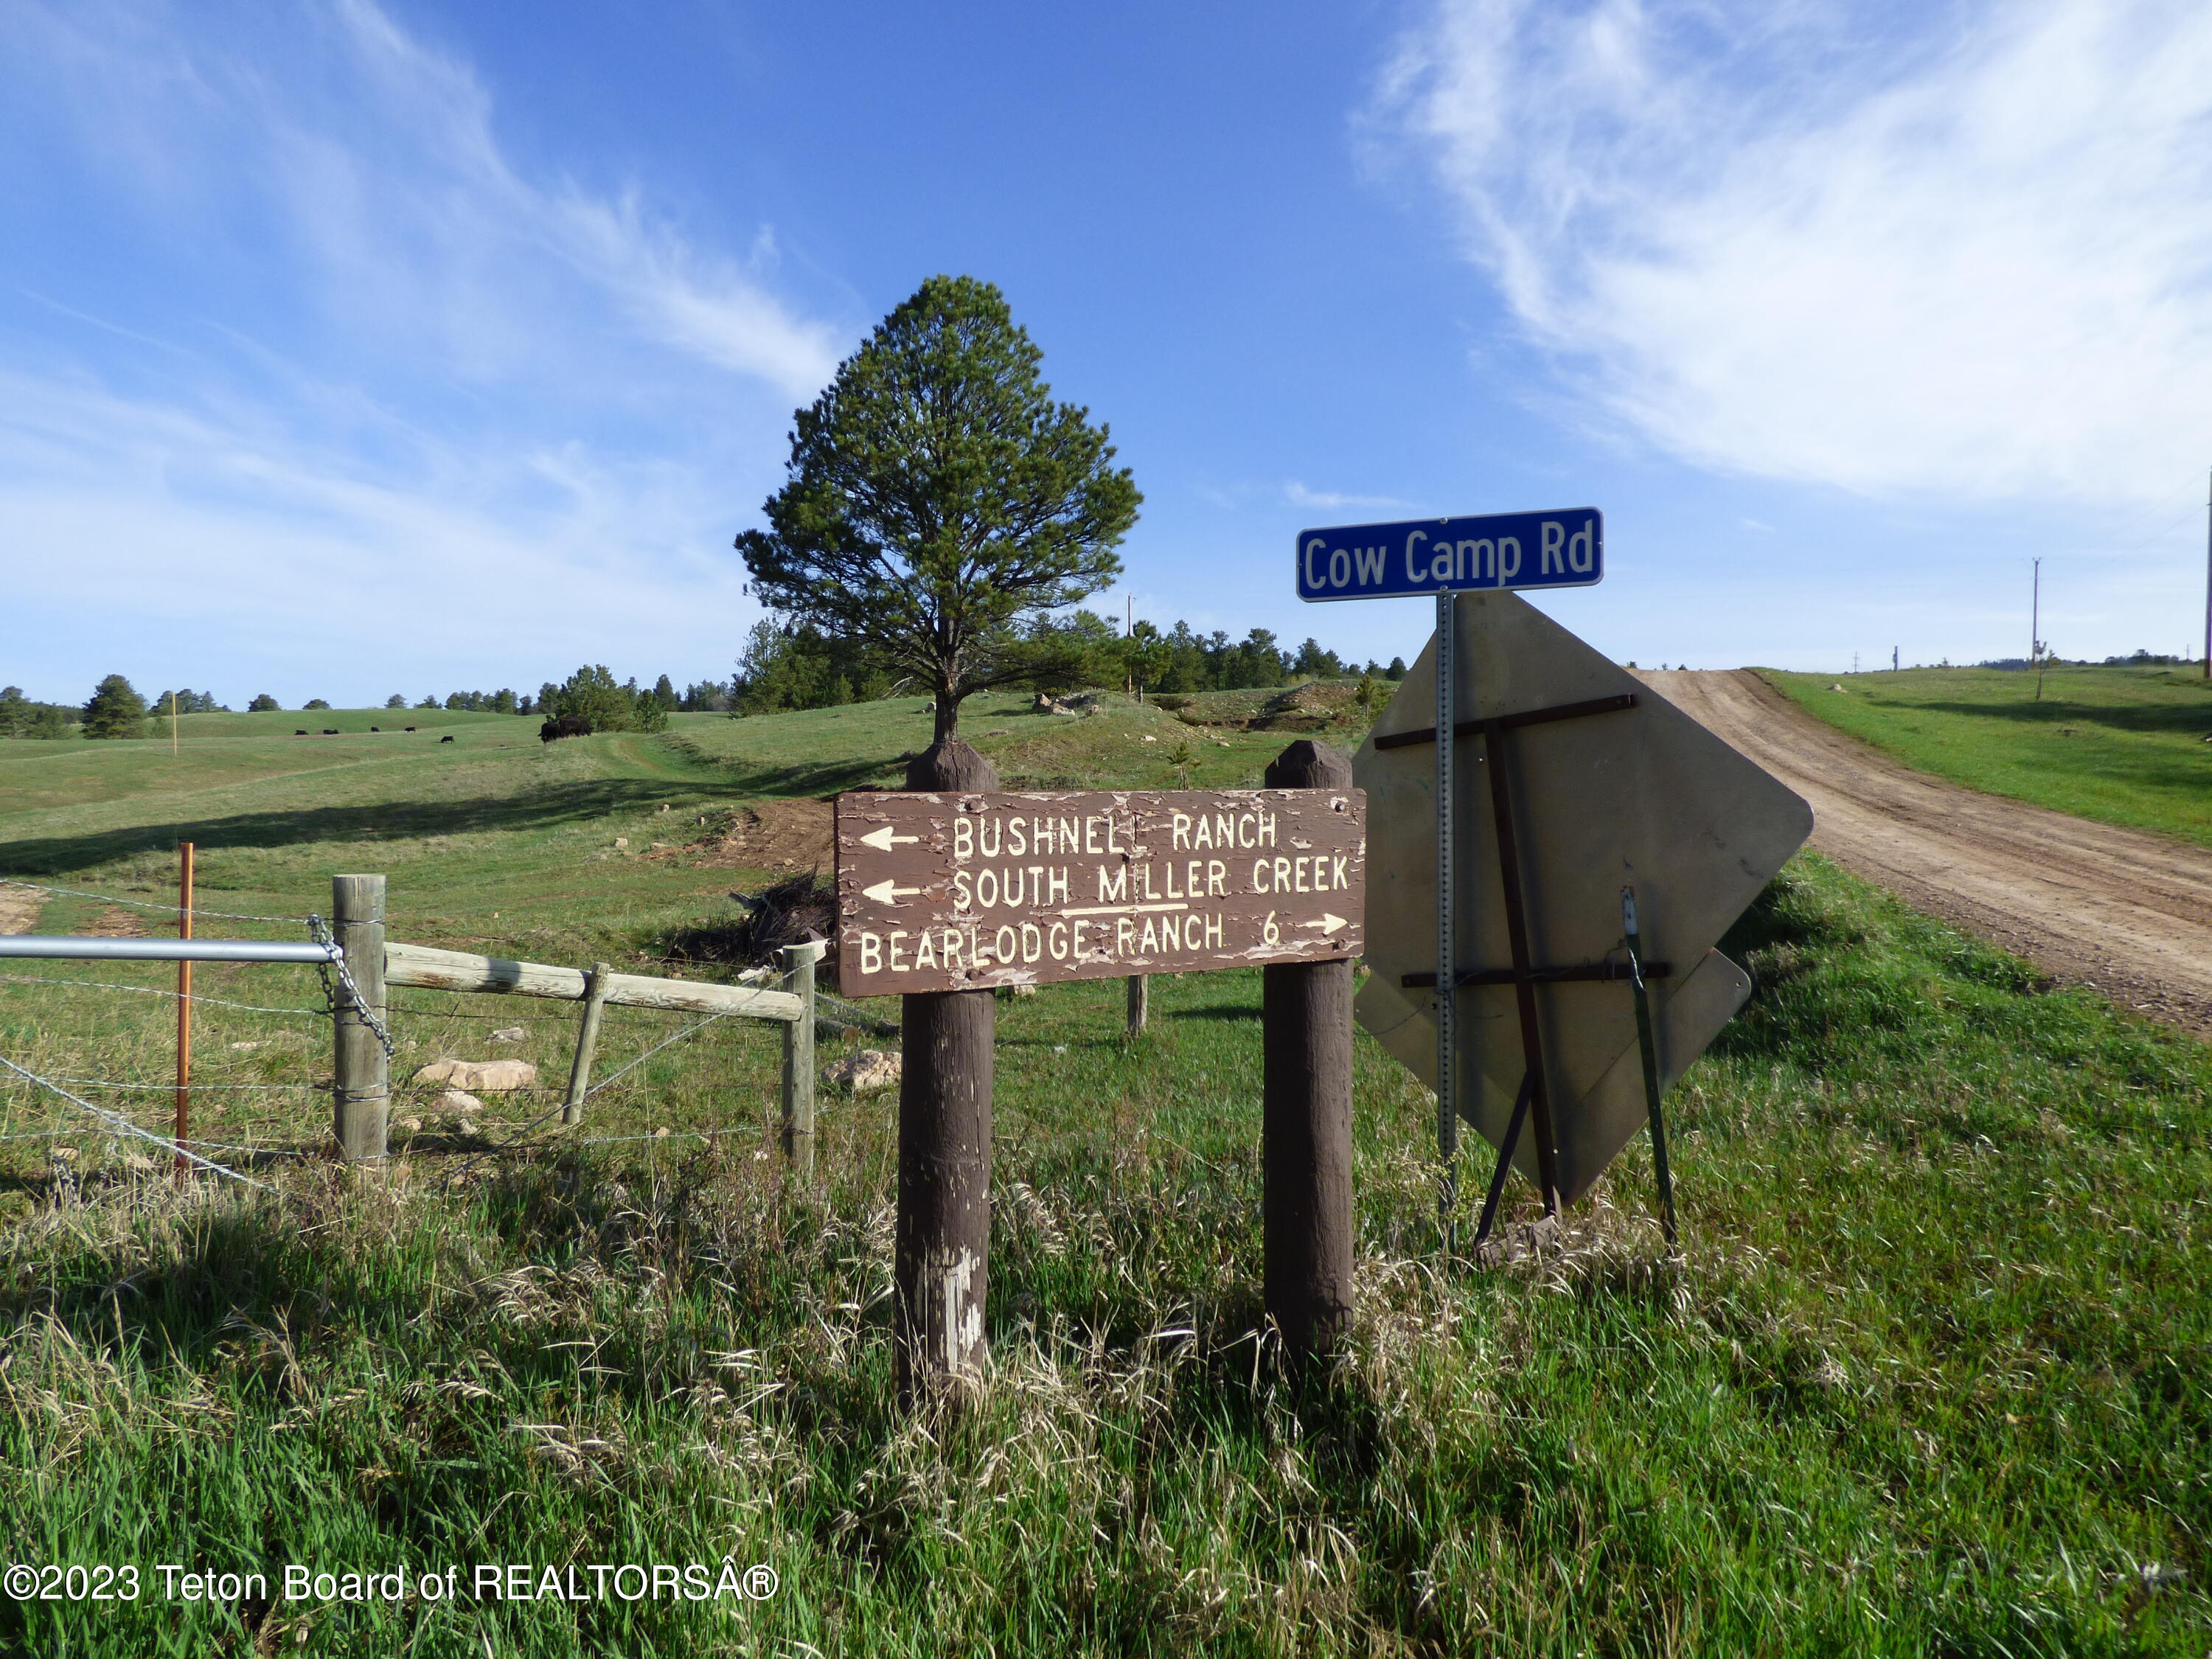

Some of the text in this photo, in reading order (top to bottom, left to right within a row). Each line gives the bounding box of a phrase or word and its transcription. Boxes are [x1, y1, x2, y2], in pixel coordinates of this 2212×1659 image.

[1305, 518, 1593, 589] Cow Camp Rd
[953, 812, 1276, 858] BUSHNELL RANCH
[953, 855, 1349, 911] SOUTH MILLER CREEK
[860, 910, 1281, 975] BEARLODGE RANCH 6
